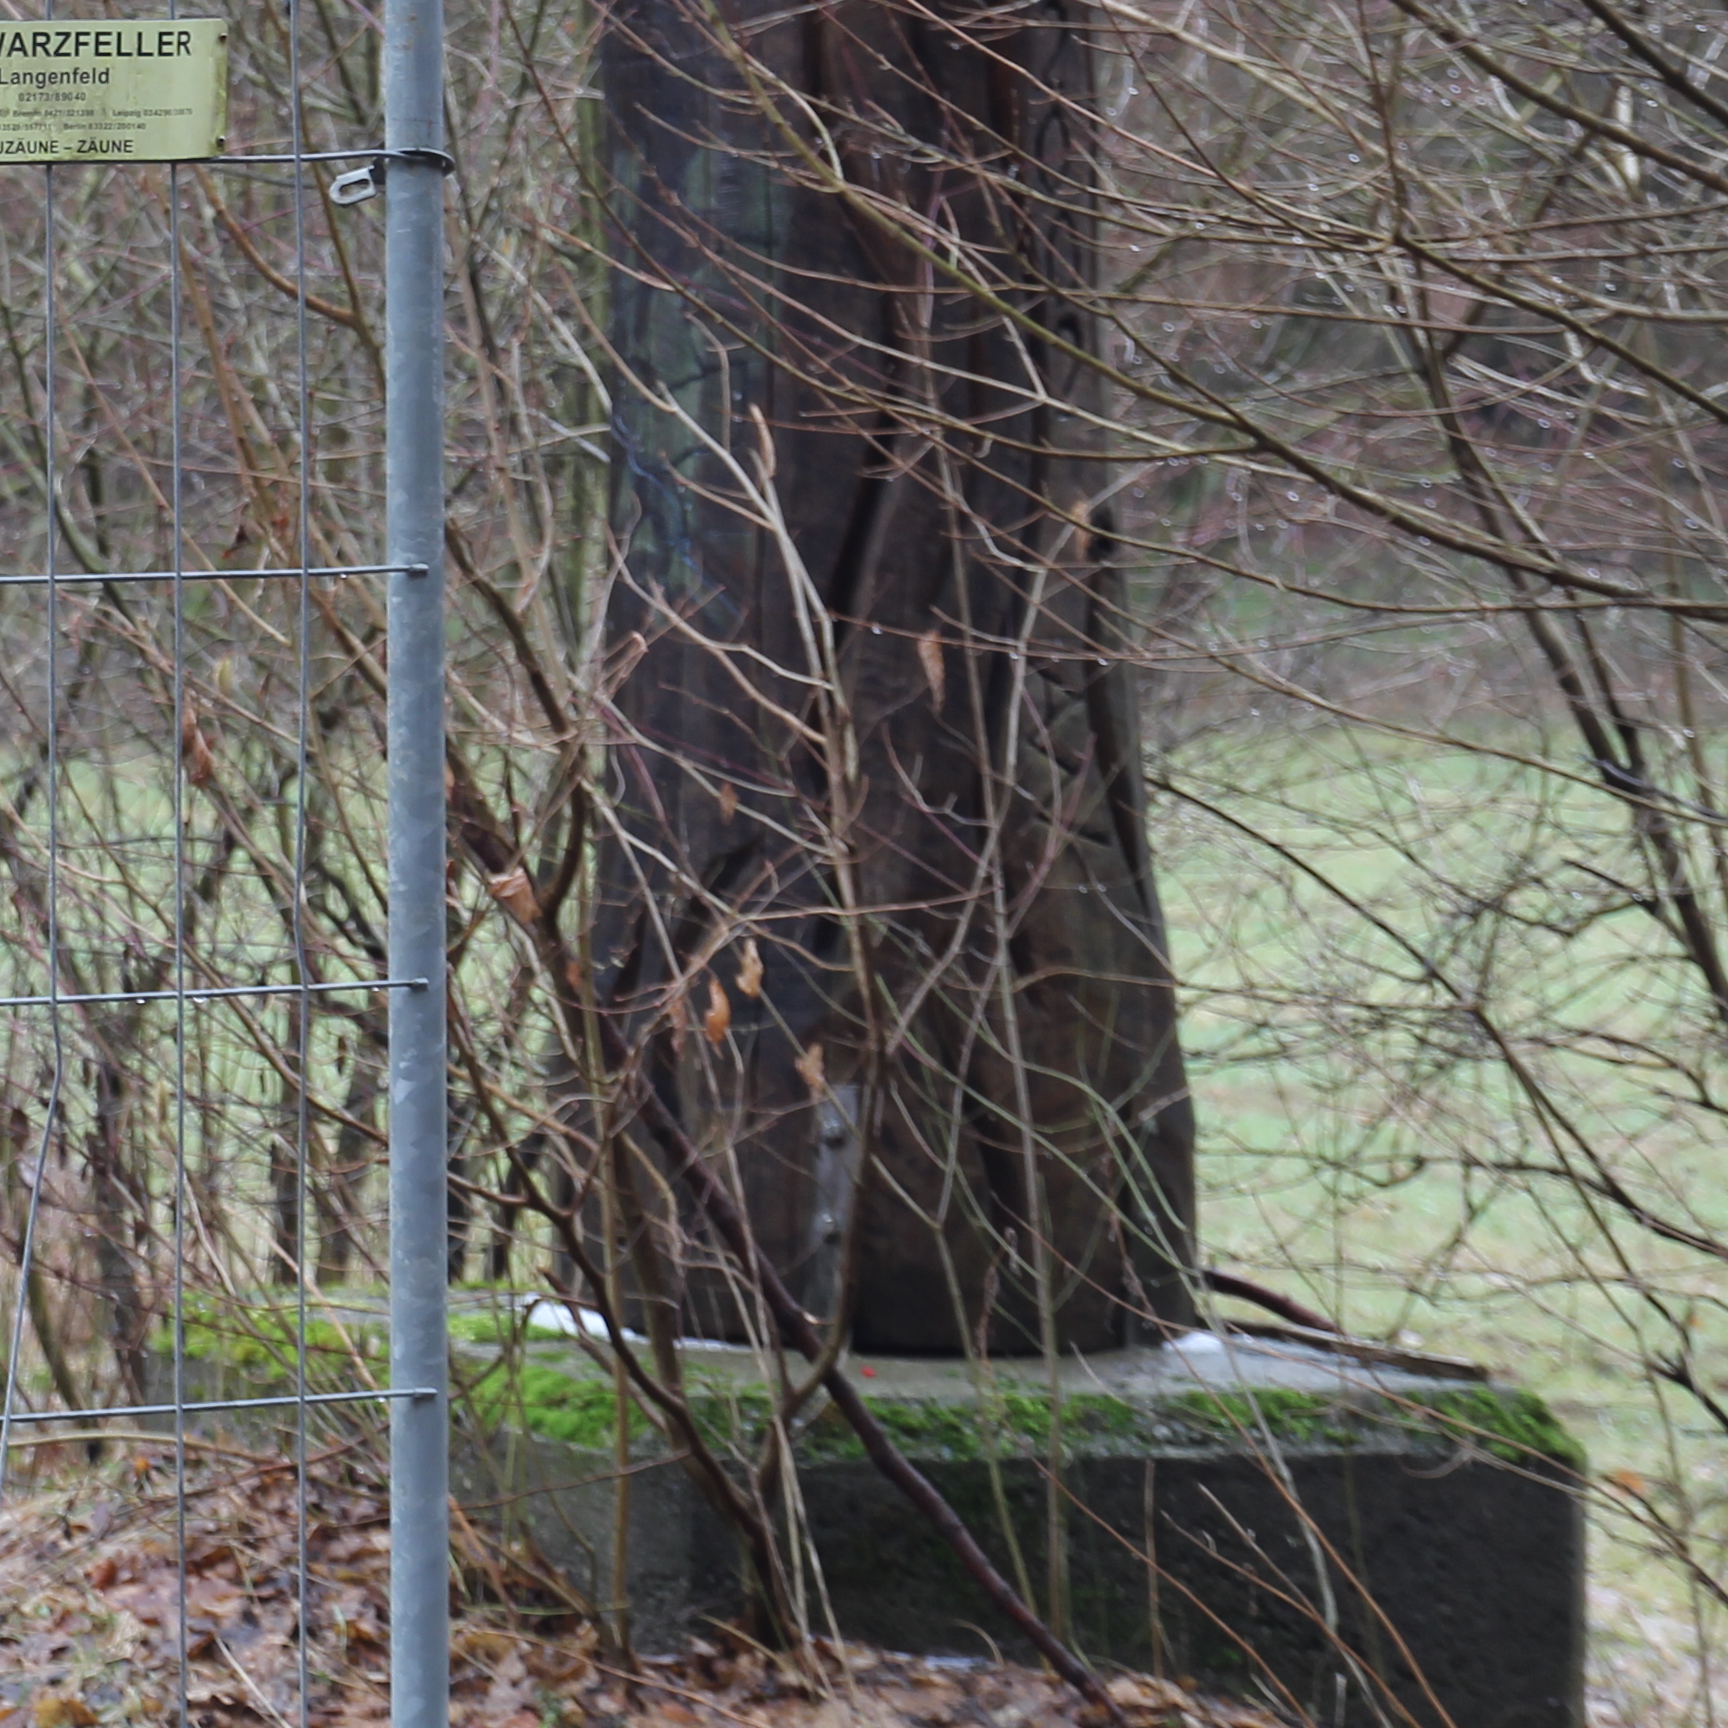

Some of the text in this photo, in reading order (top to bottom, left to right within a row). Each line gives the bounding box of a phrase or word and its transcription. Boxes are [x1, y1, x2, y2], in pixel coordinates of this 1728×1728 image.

[113, 109, 142, 118] Leipzig
[63, 122, 87, 131] Berlin
[77, 137, 134, 154] ZÄUNE
